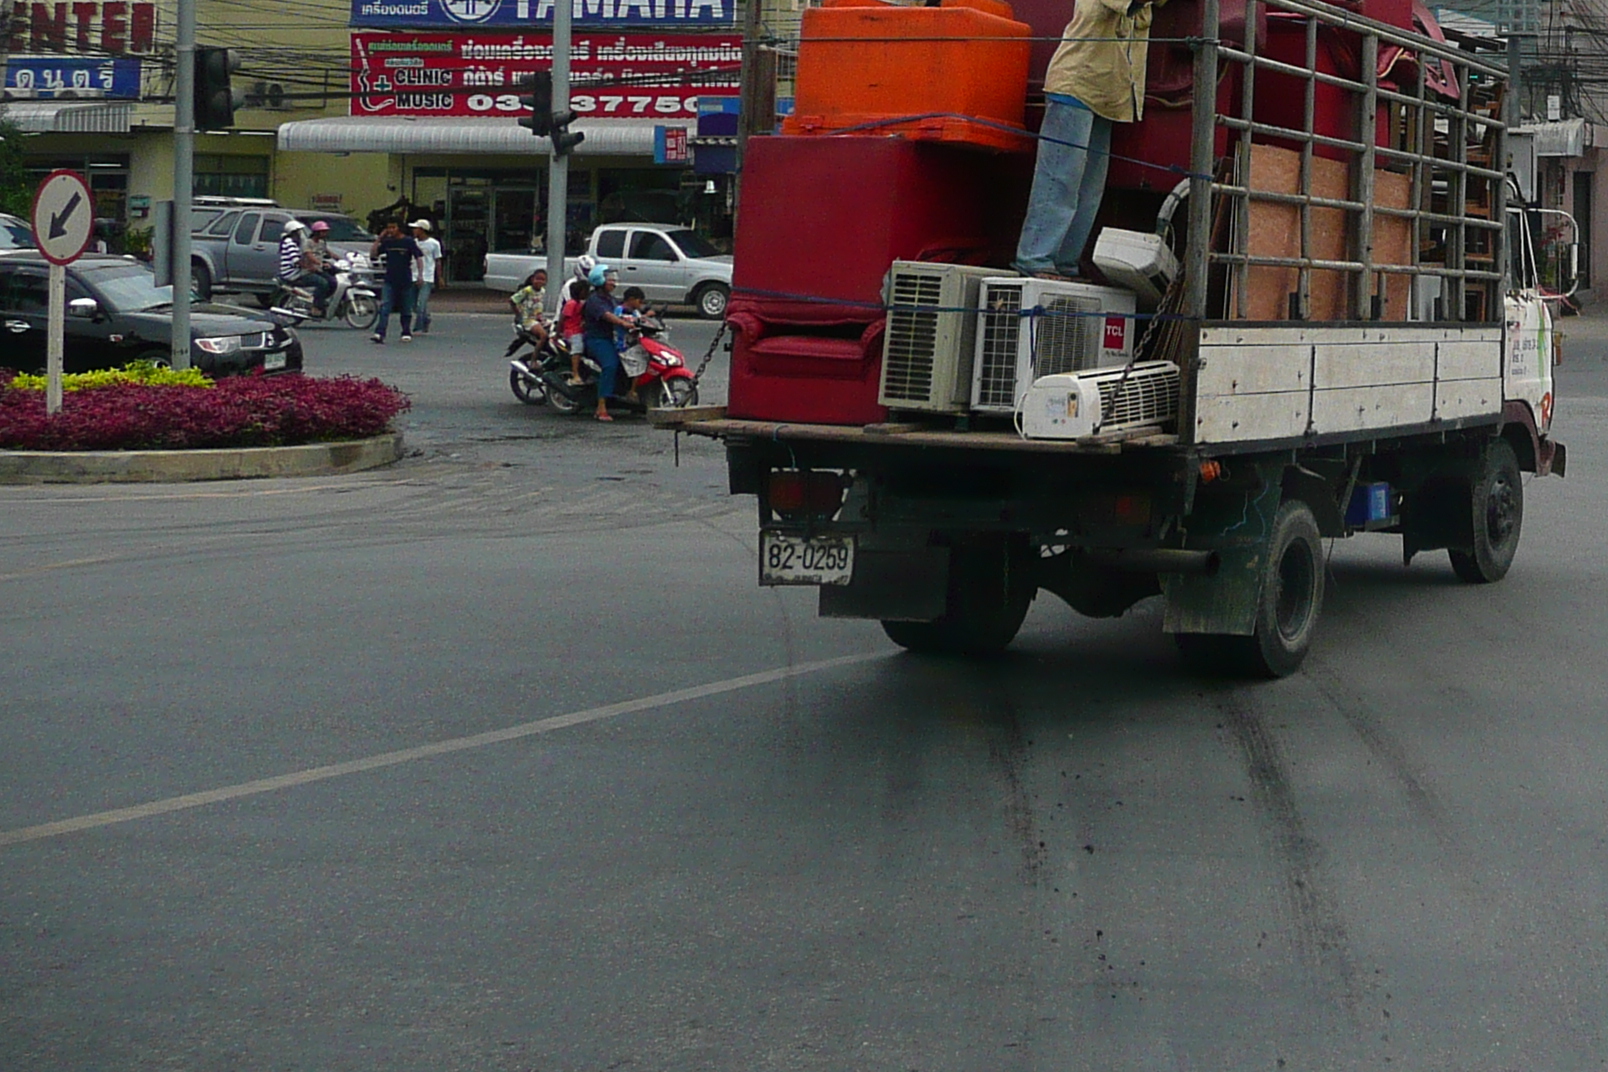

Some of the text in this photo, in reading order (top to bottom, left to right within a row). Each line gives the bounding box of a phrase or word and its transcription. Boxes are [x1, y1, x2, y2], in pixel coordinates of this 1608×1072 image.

[395, 69, 452, 86] CLINIC
[396, 93, 453, 109] MUSIC
[1106, 325, 1123, 337] TCL
[769, 543, 849, 570] 82-0259
